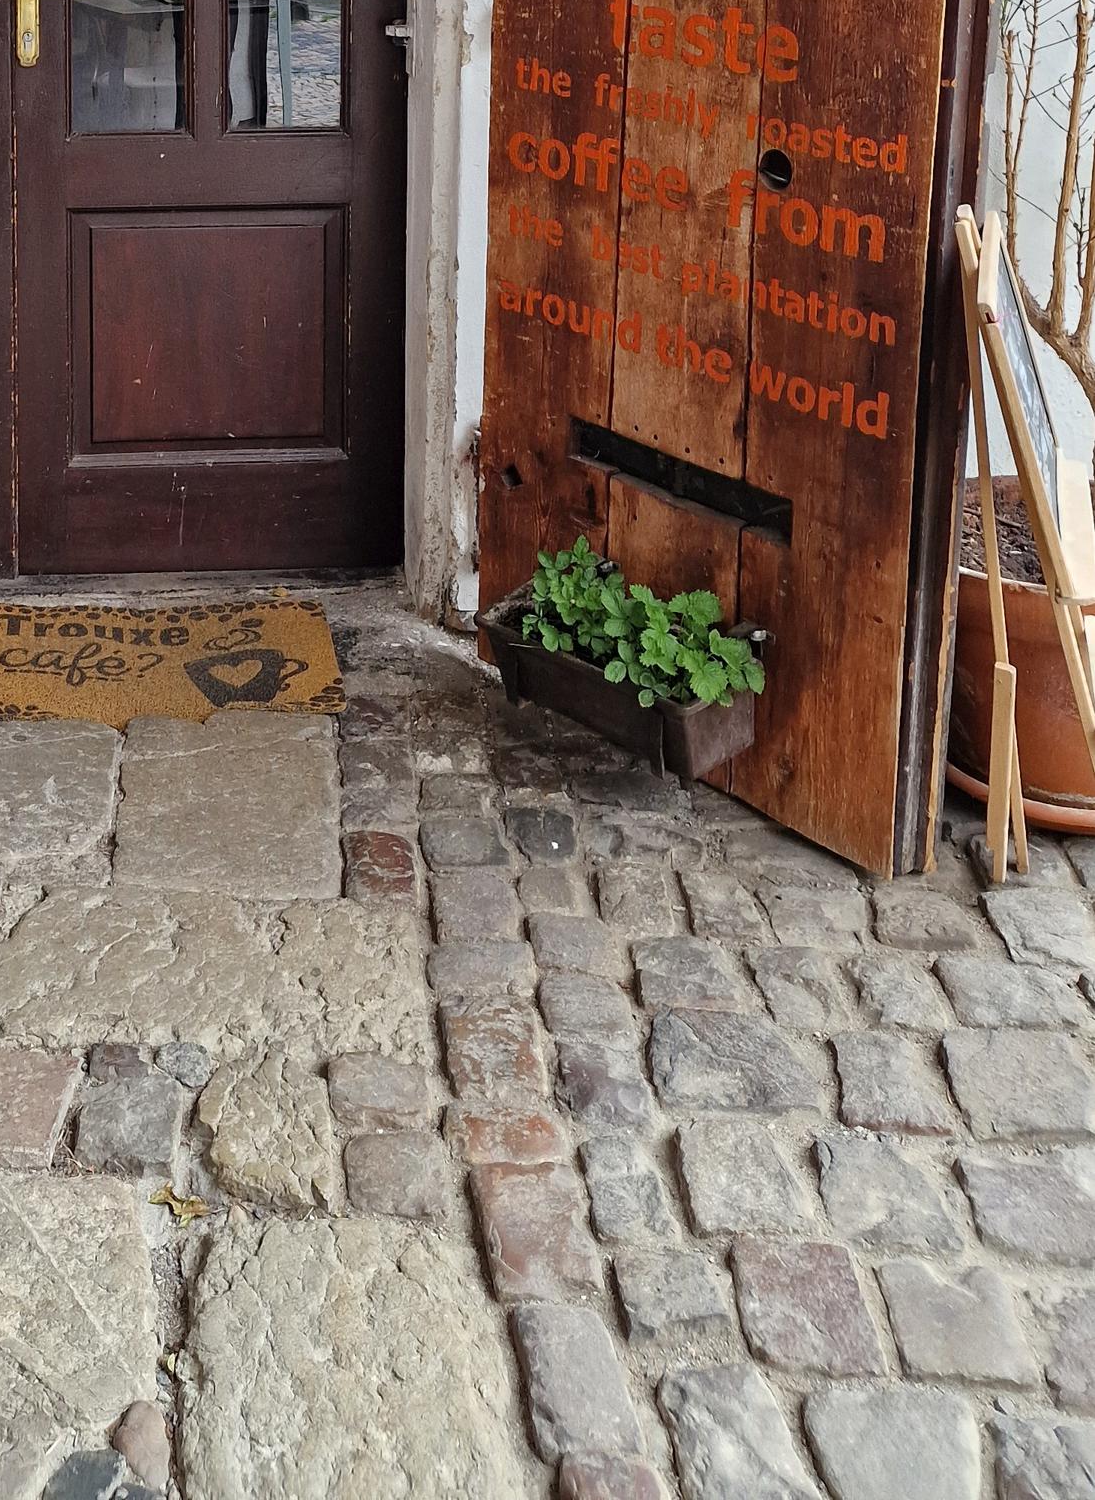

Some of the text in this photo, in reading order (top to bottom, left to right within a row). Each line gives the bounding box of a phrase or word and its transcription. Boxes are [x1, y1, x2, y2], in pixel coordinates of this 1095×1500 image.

[515, 57, 908, 174] the freshly roasted
[508, 131, 887, 264] coffee from
[508, 203, 897, 347] the best plantation
[499, 280, 890, 440] around the world
[0, 613, 190, 647] Trouxe
